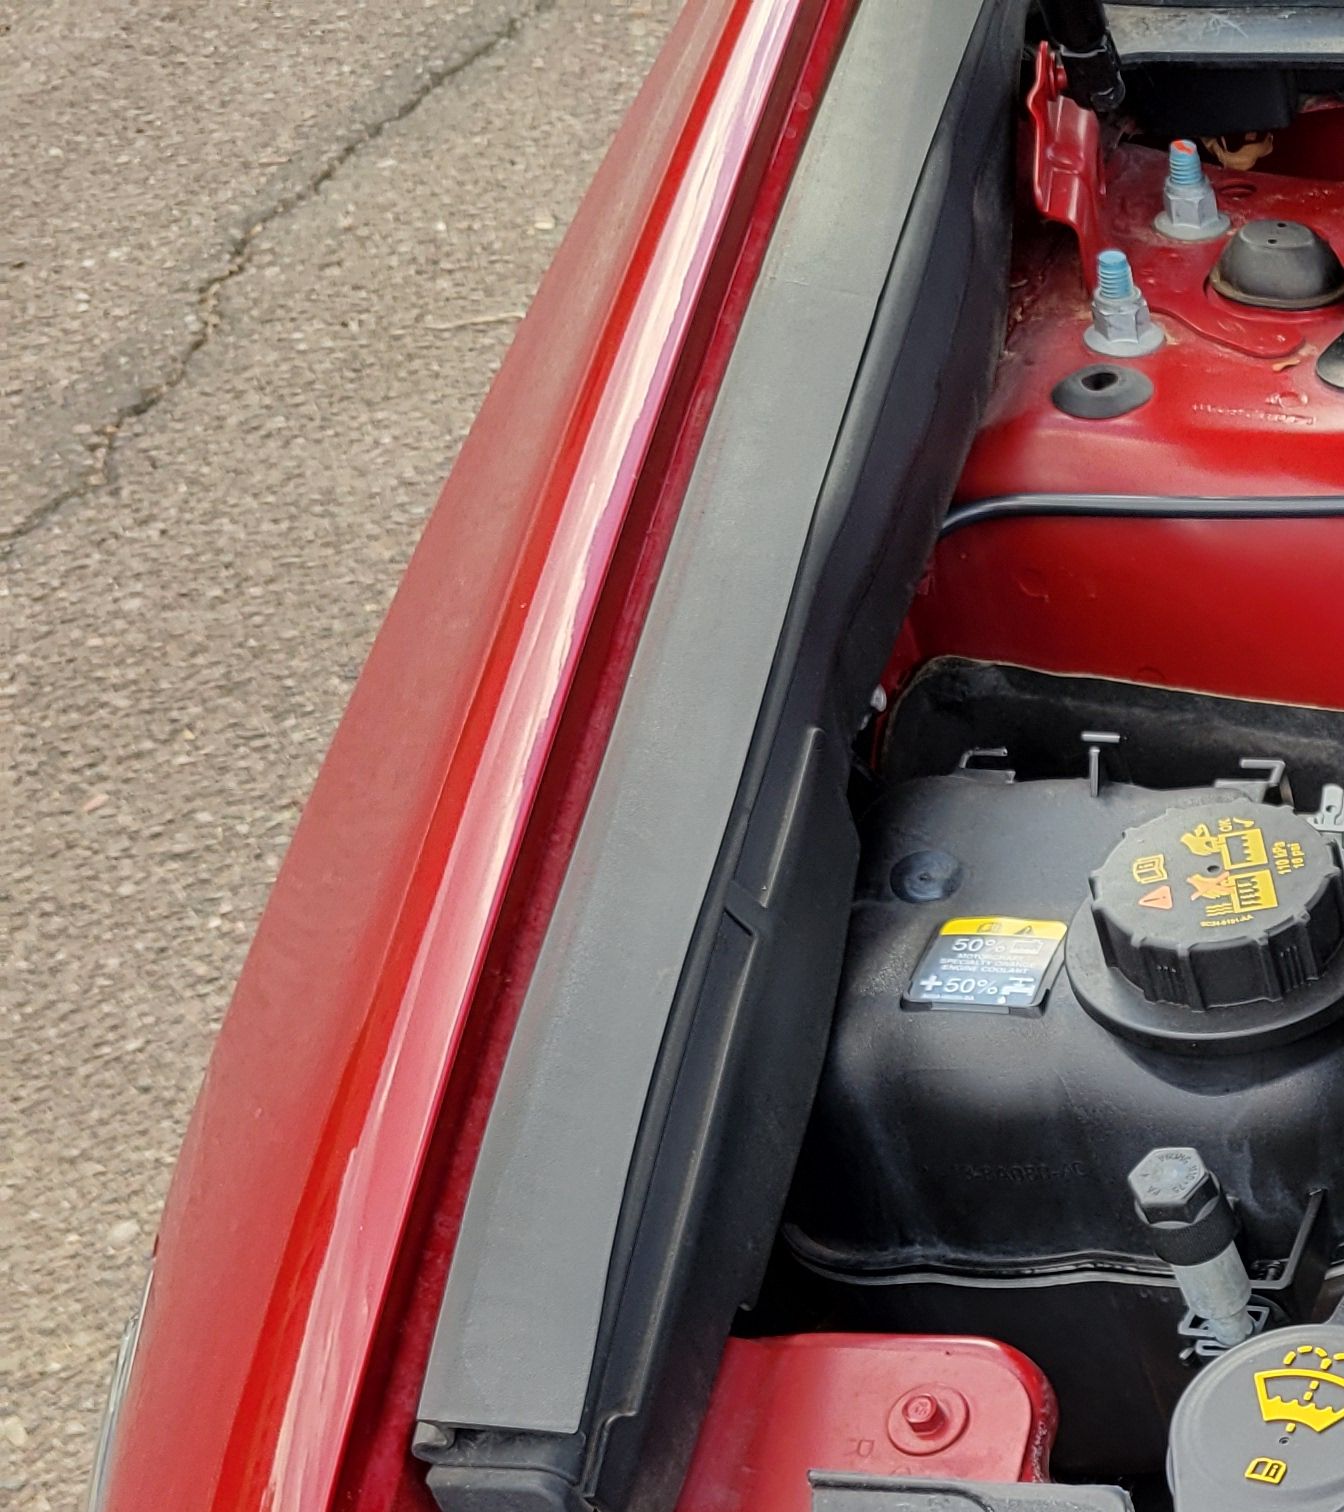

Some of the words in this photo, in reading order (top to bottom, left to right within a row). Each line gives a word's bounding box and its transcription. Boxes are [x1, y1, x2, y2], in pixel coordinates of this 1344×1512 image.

[1272, 841, 1288, 858] kPa
[1287, 842, 1305, 857] psi
[1275, 859, 1292, 875] 110
[952, 938, 1006, 952] 50%
